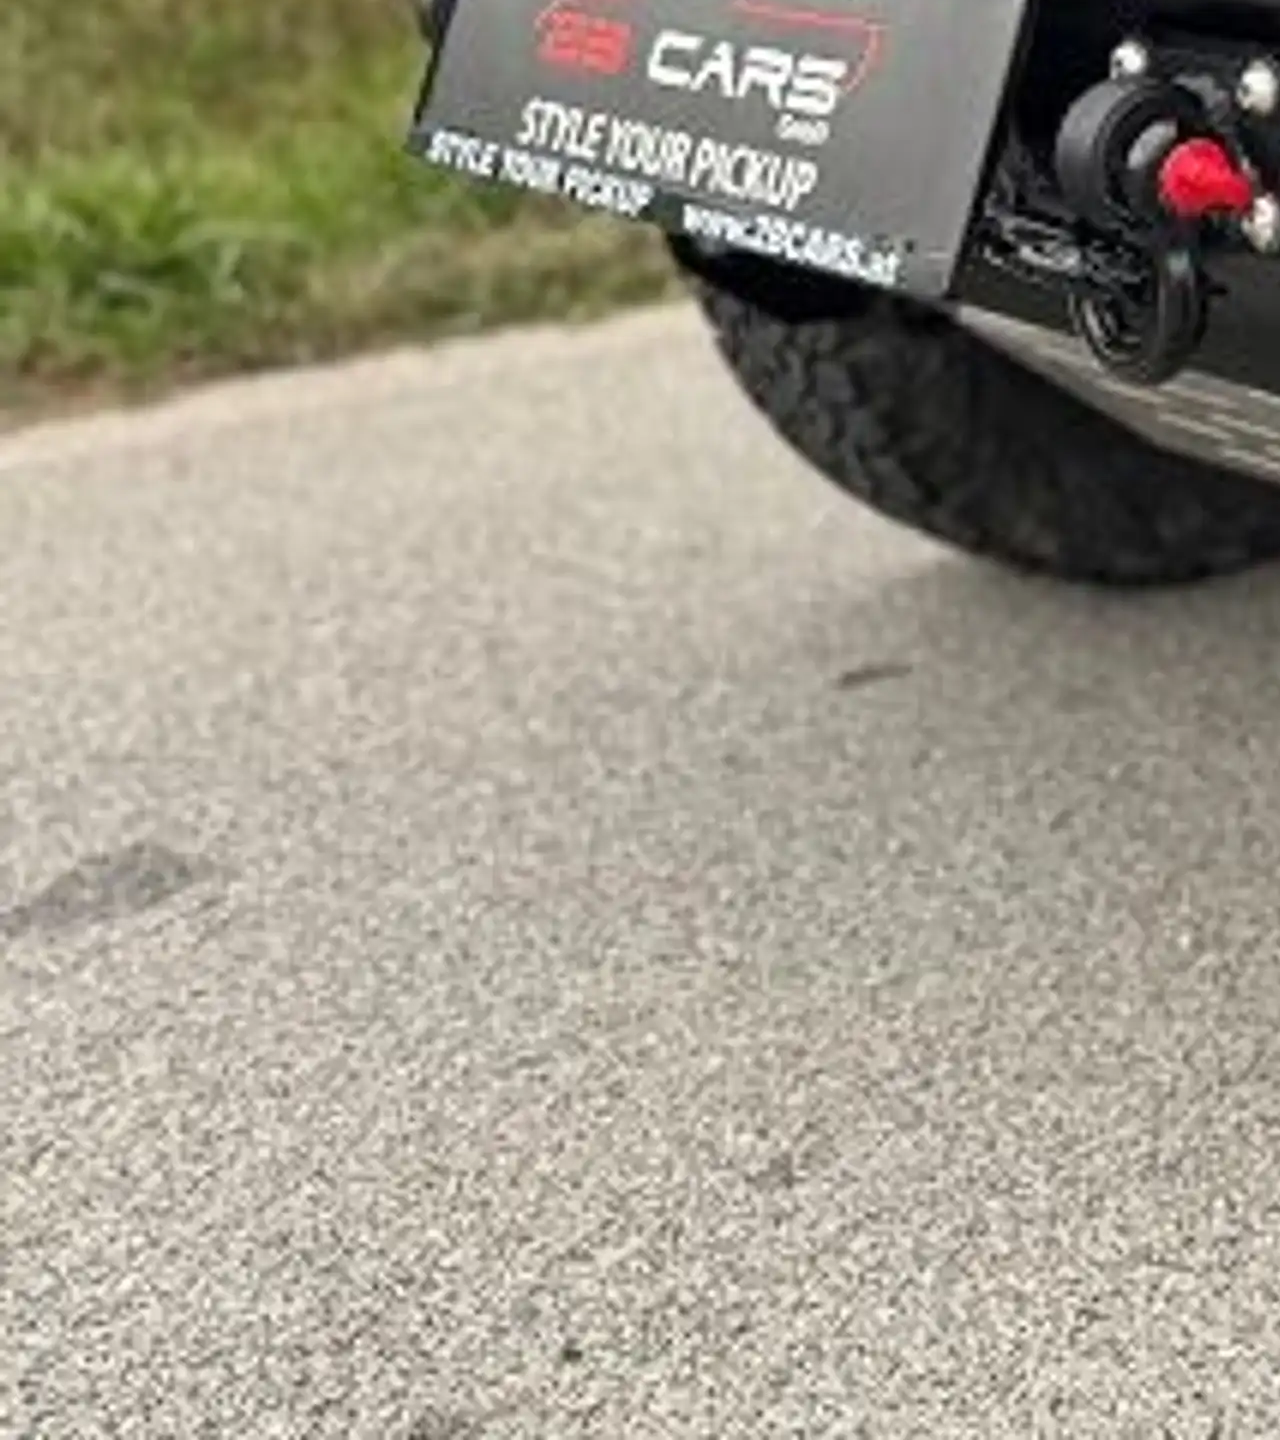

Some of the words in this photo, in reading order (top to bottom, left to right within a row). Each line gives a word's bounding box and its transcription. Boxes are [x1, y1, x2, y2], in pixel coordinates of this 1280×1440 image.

[647, 28, 847, 115] CARS
[426, 128, 499, 177] STYLE
[515, 97, 607, 160] STYLE
[605, 116, 692, 182] YOUR
[689, 137, 818, 211] PICKUP
